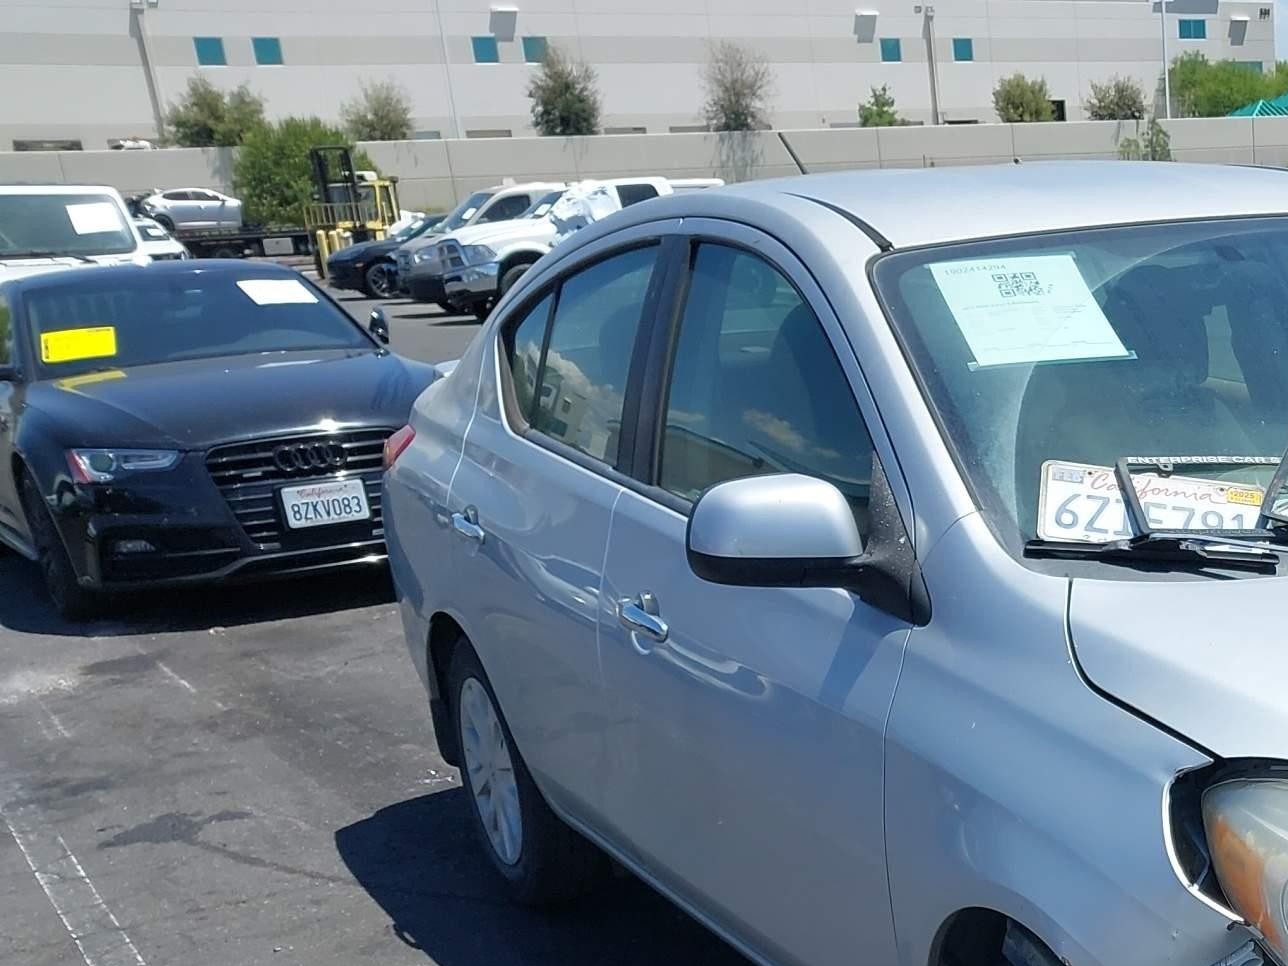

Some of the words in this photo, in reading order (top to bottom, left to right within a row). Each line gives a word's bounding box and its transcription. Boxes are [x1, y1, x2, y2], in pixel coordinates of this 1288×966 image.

[1127, 455, 1229, 464] ENTERPRISE
[1231, 455, 1264, 464] CAR
[291, 495, 362, 521] 8ZKV083
